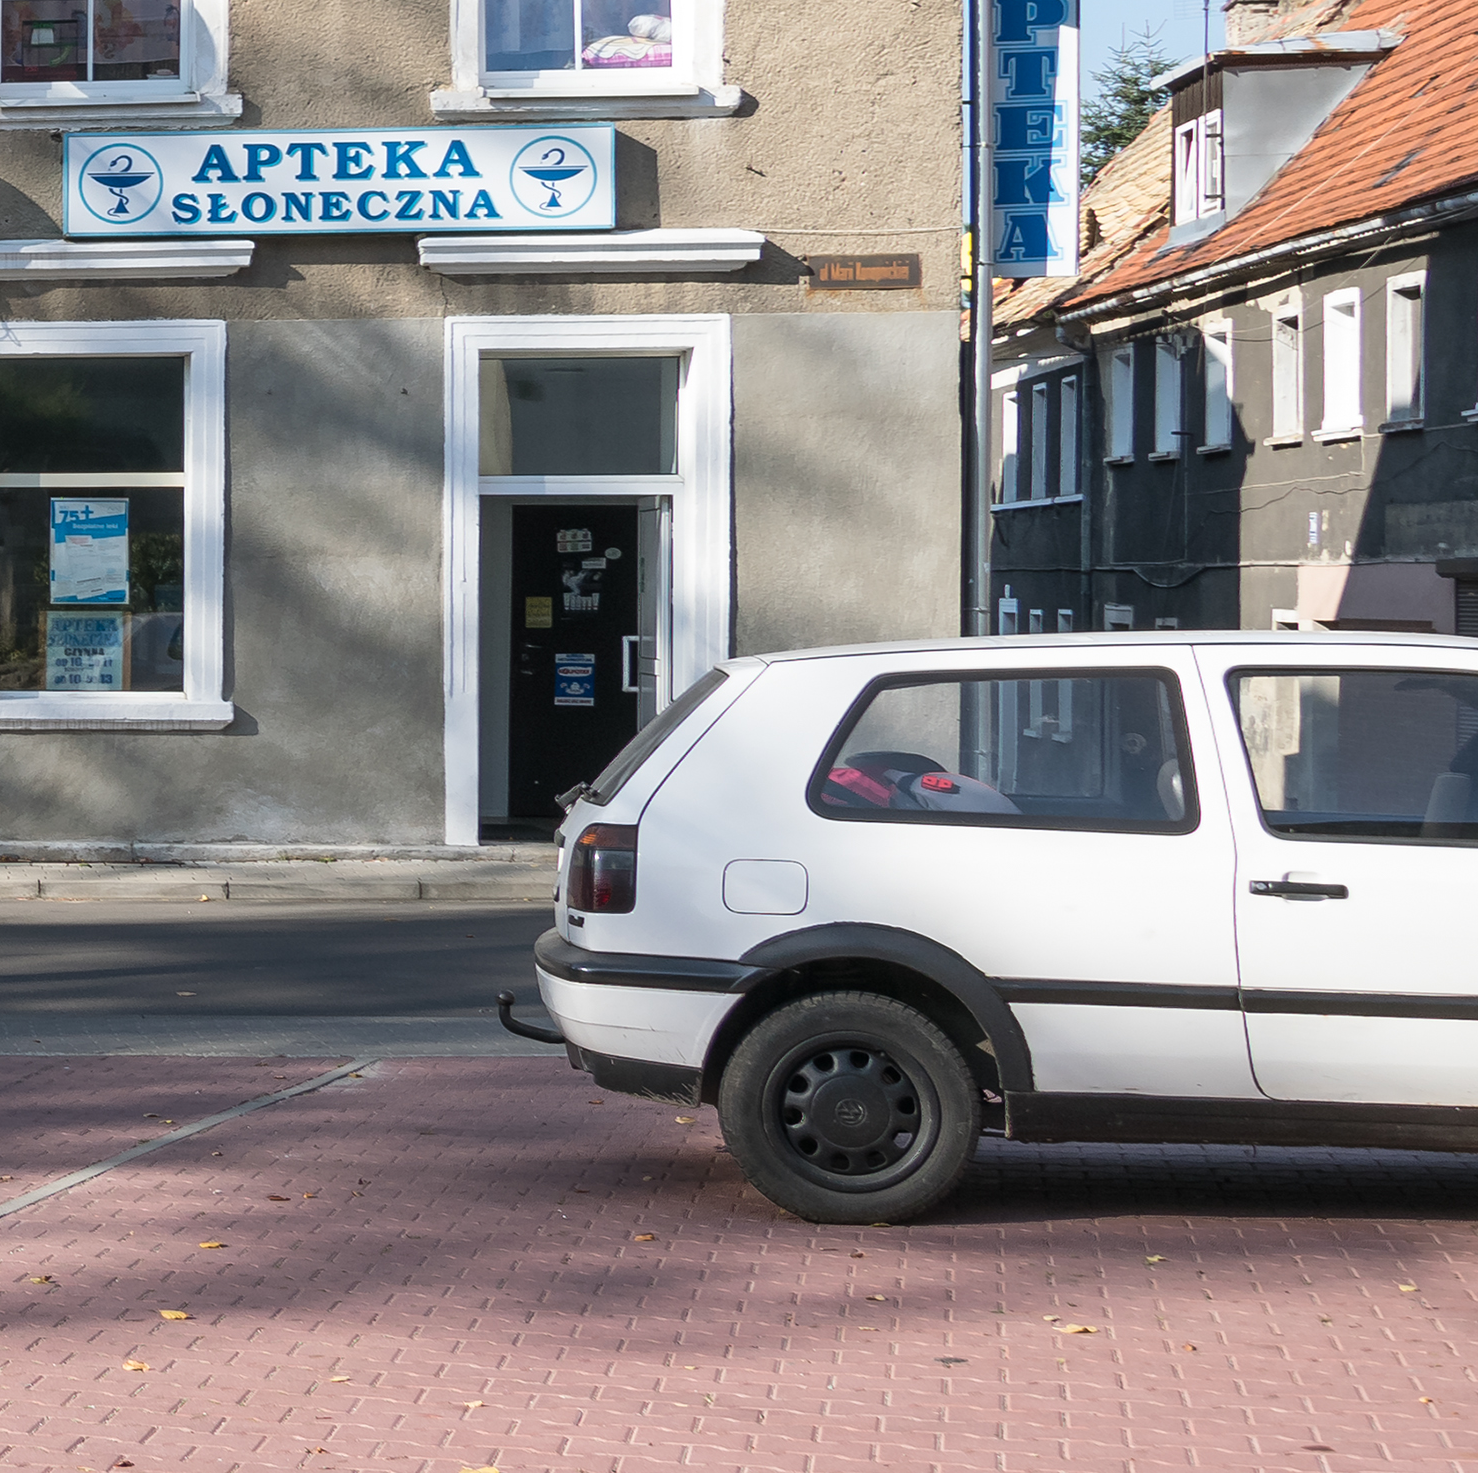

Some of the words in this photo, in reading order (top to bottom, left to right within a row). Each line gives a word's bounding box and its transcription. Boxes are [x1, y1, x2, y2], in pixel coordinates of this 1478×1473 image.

[191, 139, 482, 184] APTEKA
[171, 188, 503, 226] SŁONECZNA
[58, 505, 94, 524] 75+
